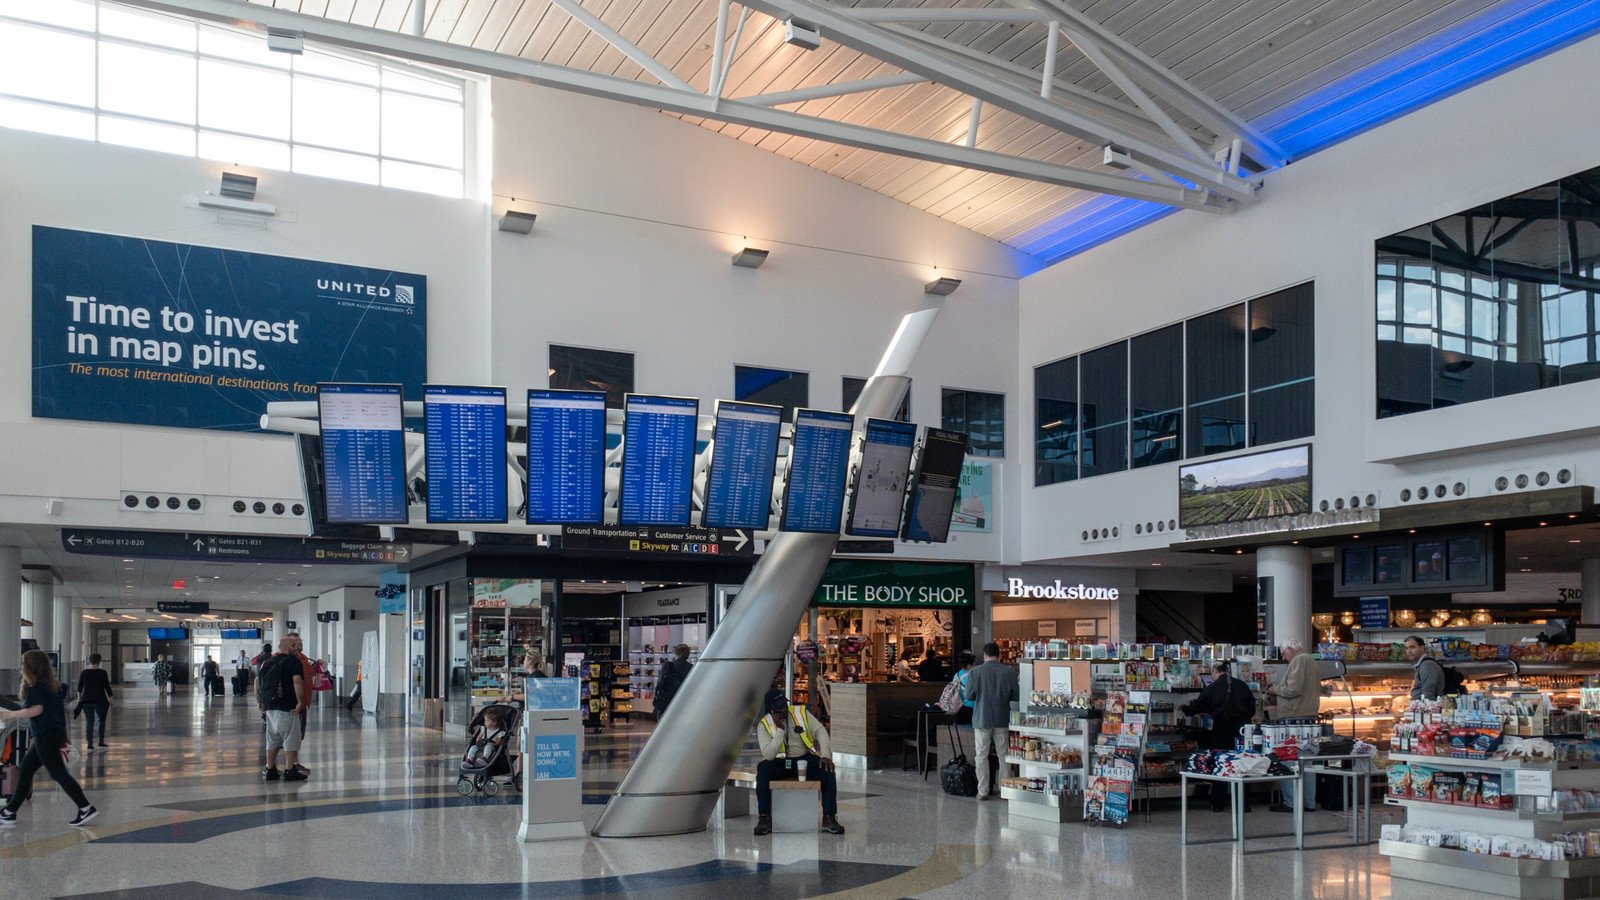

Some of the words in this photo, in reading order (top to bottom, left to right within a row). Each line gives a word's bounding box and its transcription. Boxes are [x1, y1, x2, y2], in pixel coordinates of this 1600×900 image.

[317, 279, 391, 297] UNITED
[356, 303, 381, 311] ALLIANCE
[66, 296, 151, 329] Time
[160, 306, 194, 333] to
[205, 309, 299, 344] invest
[68, 326, 98, 355] in
[110, 336, 182, 366] map
[193, 340, 265, 371] pins.
[69, 362, 93, 375] The
[97, 366, 129, 378] most
[134, 367, 213, 385] international
[217, 376, 289, 392] destinations
[567, 526, 591, 535] Ground
[592, 528, 637, 537] Transportation
[655, 531, 684, 540] Customer
[685, 533, 707, 541] Service
[116, 538, 145, 547] B12-B20
[236, 538, 262, 546] B21-B31
[341, 542, 366, 551] Baggage
[218, 547, 250, 555] Restrooms
[642, 542, 669, 551] Skyway
[671, 543, 680, 551] to:
[683, 544, 689, 552] A
[692, 544, 699, 552] C
[702, 544, 708, 552] D
[712, 545, 717, 553] E
[326, 551, 350, 560] Skyway
[822, 584, 858, 601] THE
[865, 585, 914, 602] BODY
[1007, 577, 1119, 600] Brookstone
[537, 751, 552, 759] HOW
[537, 772, 550, 780] IAH
